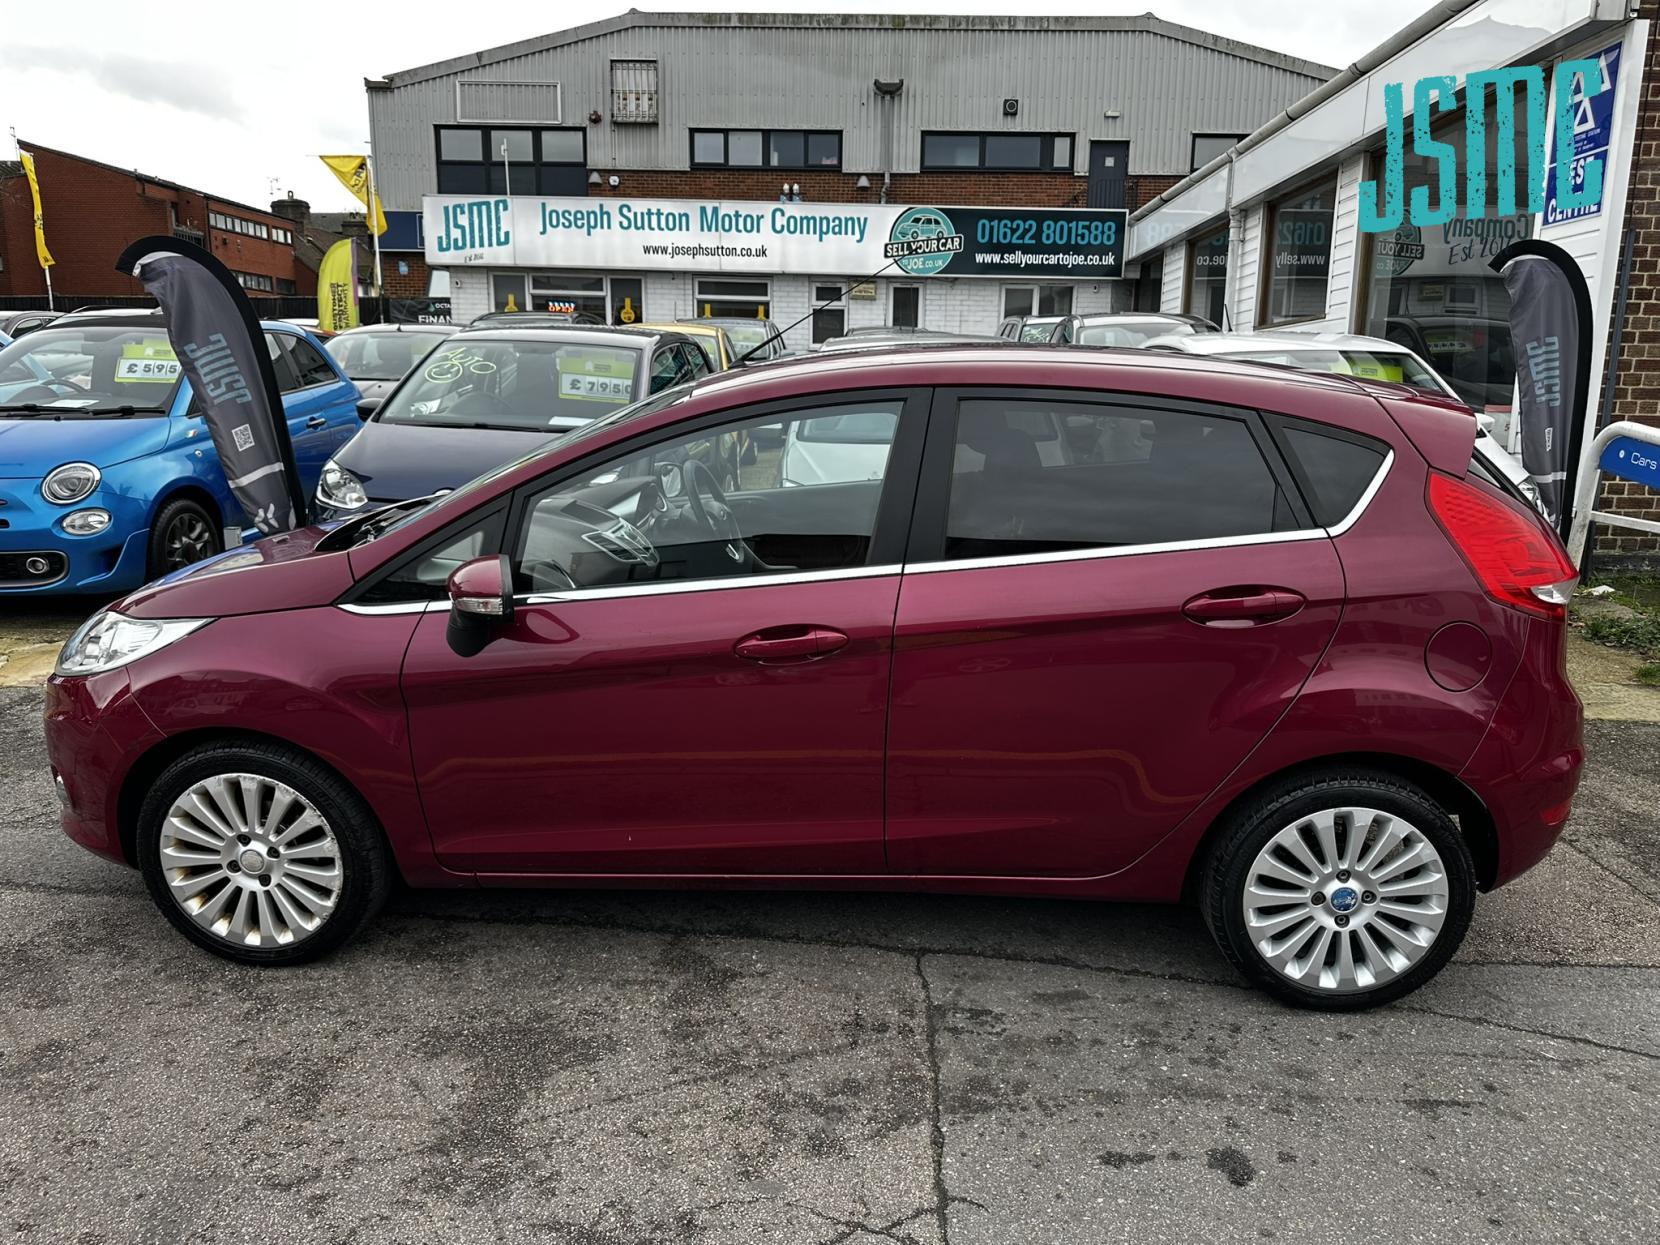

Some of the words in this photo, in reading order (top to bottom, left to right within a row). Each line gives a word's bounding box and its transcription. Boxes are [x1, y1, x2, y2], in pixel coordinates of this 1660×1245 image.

[437, 199, 510, 252] JSMC
[539, 202, 612, 236] Joseph
[618, 203, 690, 232] Sutton
[699, 206, 764, 233] Motor
[771, 207, 868, 243] Company
[977, 219, 1037, 244] 01622
[1041, 220, 1116, 246] 801588
[642, 243, 768, 260] www.josephsutton.co.uk
[886, 243, 909, 256] SELL
[911, 240, 937, 254] YOUR
[939, 238, 960, 251] CAR
[975, 250, 1115, 269] www.sellyourcartojoe.co.uk
[184, 333, 252, 405] JSMC
[1631, 452, 1658, 470] Cars
